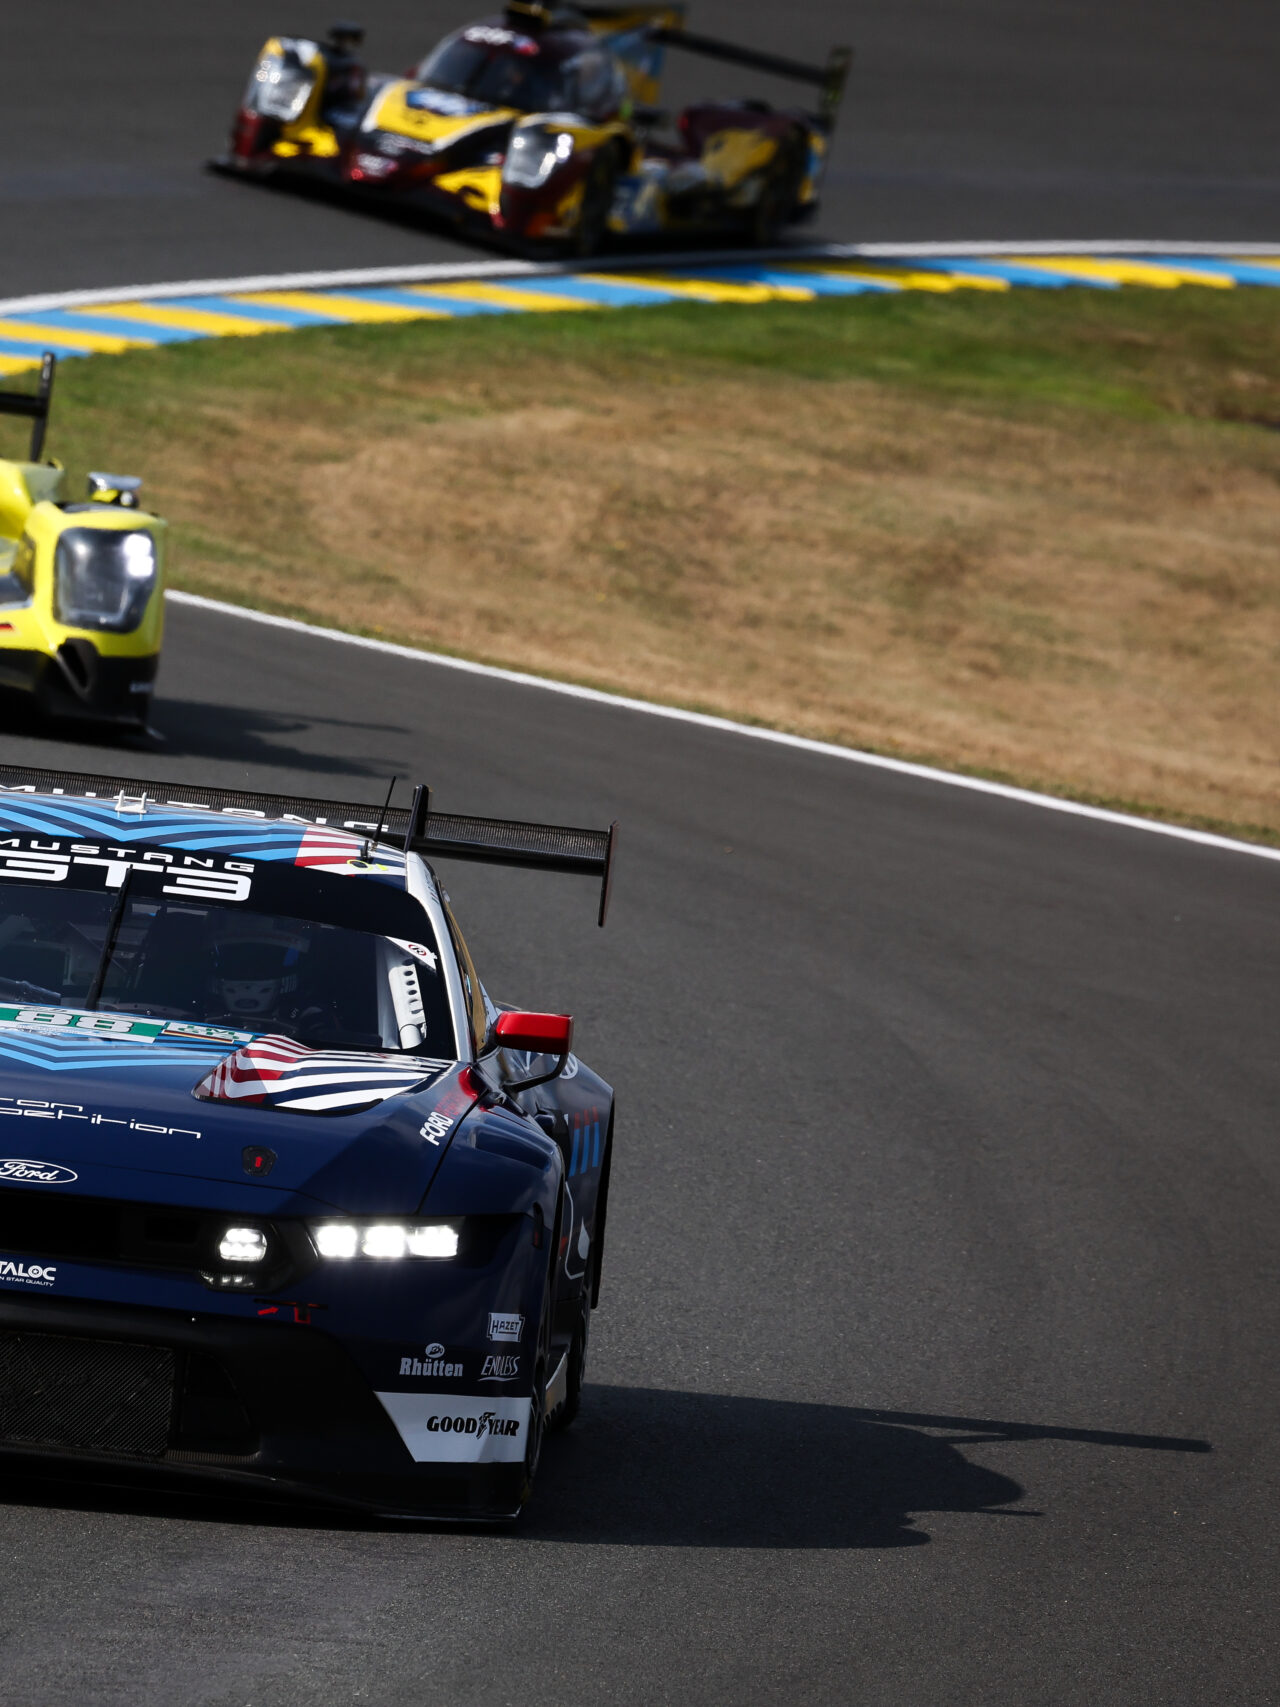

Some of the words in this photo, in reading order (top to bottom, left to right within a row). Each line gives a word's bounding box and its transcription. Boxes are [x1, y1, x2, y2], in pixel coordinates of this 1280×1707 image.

[14, 1010, 135, 1033] 88
[419, 1111, 454, 1146] FORD
[25, 1278, 54, 1286] QUALITY
[492, 1319, 520, 1333] HAZET
[398, 1357, 464, 1377] Rhütten
[480, 1355, 521, 1376] ENDLESS
[426, 1413, 520, 1438] GOODYEAR
